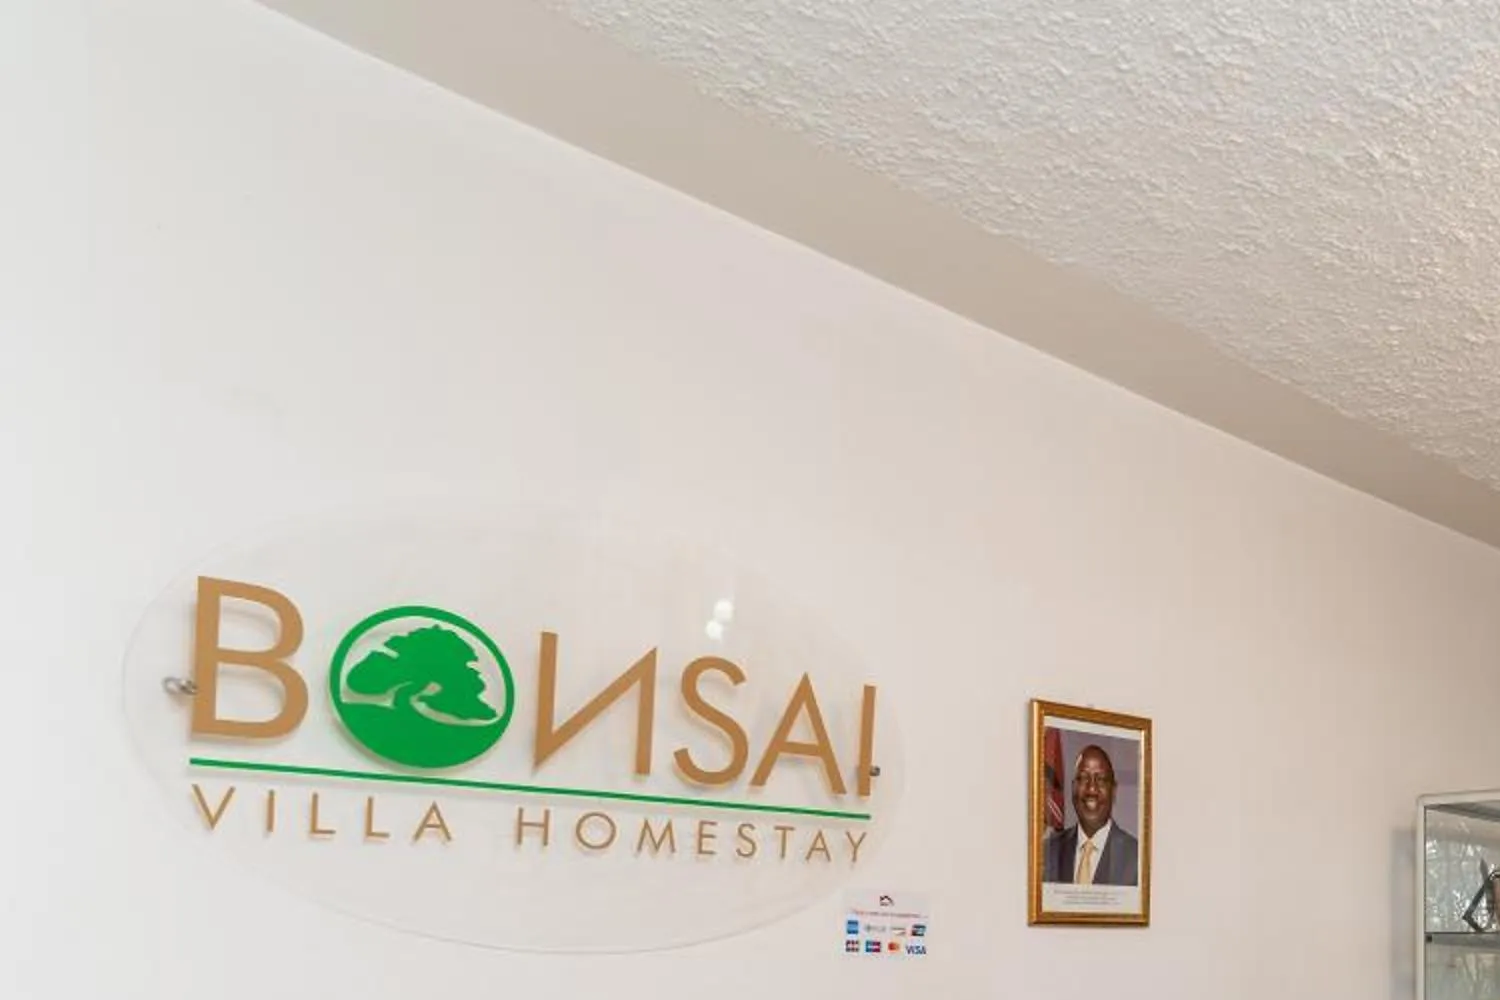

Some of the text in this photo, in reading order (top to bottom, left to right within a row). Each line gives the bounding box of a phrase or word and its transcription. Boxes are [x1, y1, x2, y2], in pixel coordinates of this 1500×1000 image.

[192, 784, 867, 862] VILLA HOMESTAY
[905, 945, 927, 955] VISA
